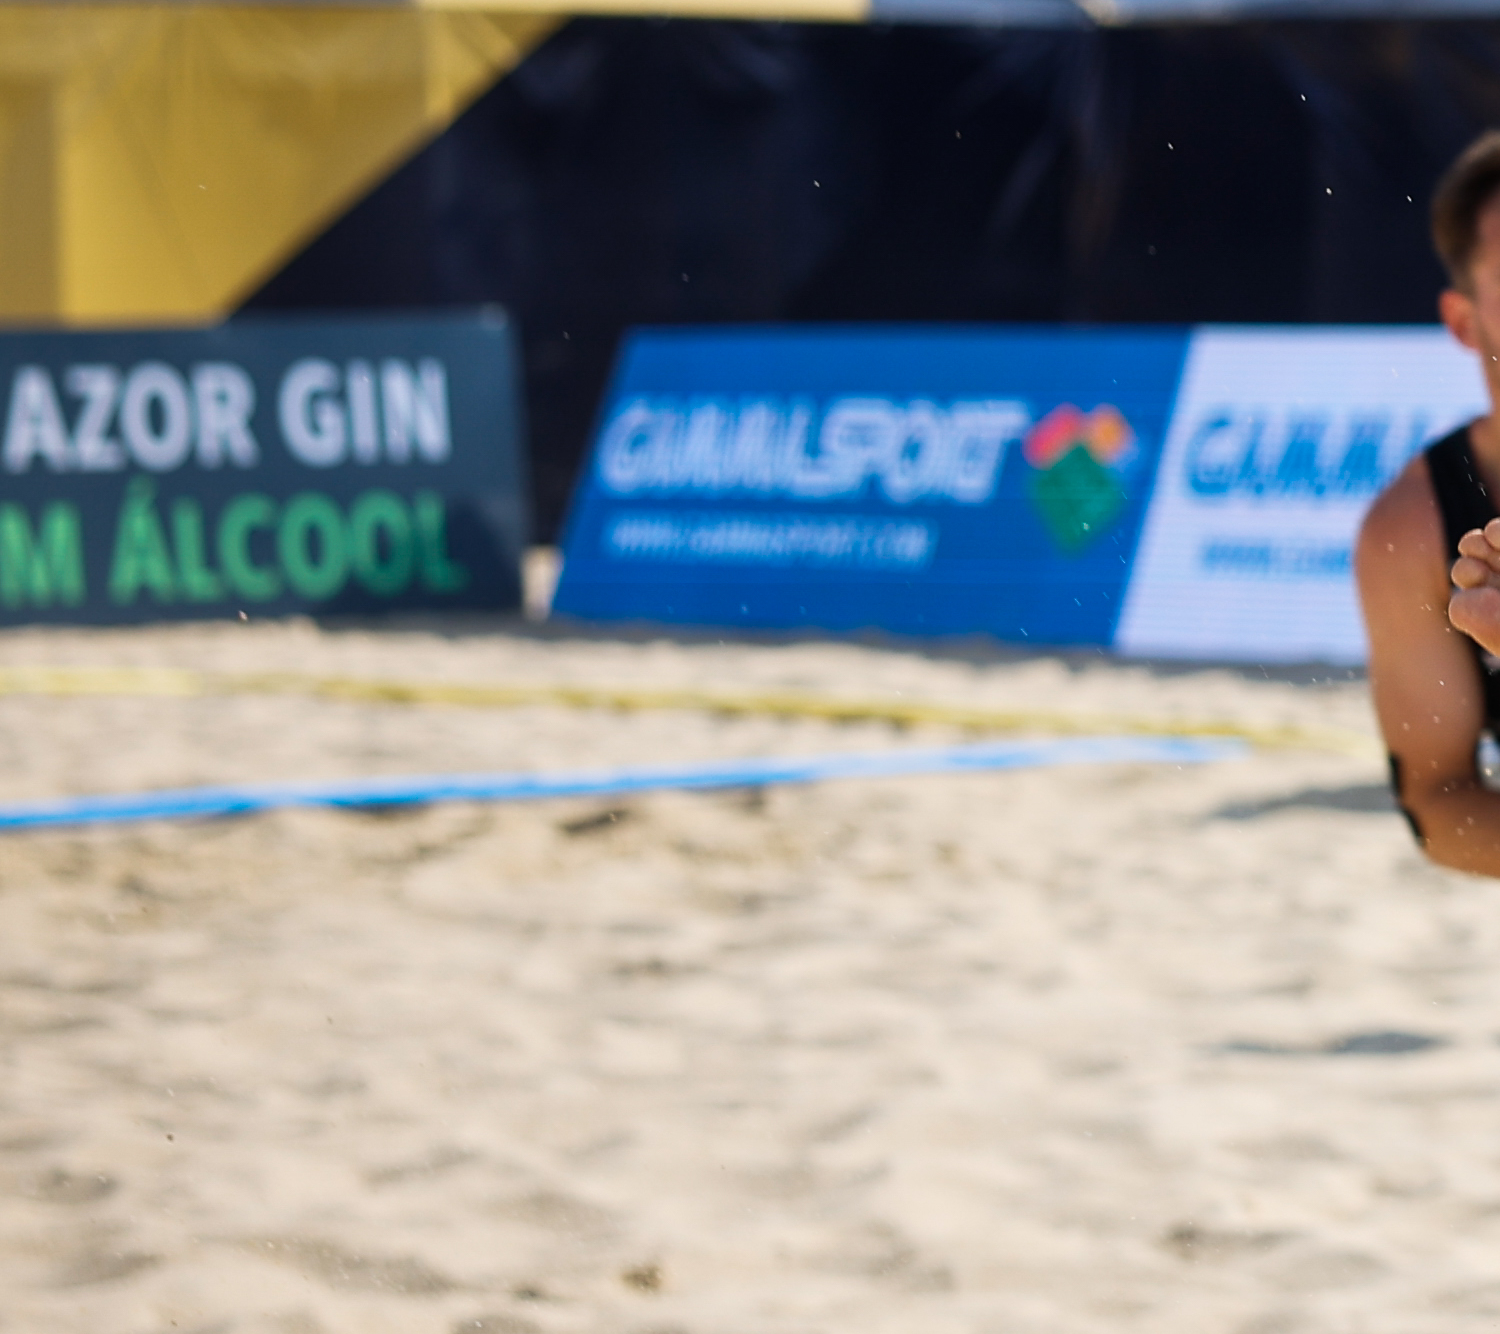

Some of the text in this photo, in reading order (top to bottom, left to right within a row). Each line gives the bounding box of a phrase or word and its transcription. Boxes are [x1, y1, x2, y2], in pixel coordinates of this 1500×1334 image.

[4, 356, 451, 471] AZOR GIN
[109, 474, 466, 605] ÁLCOOL
